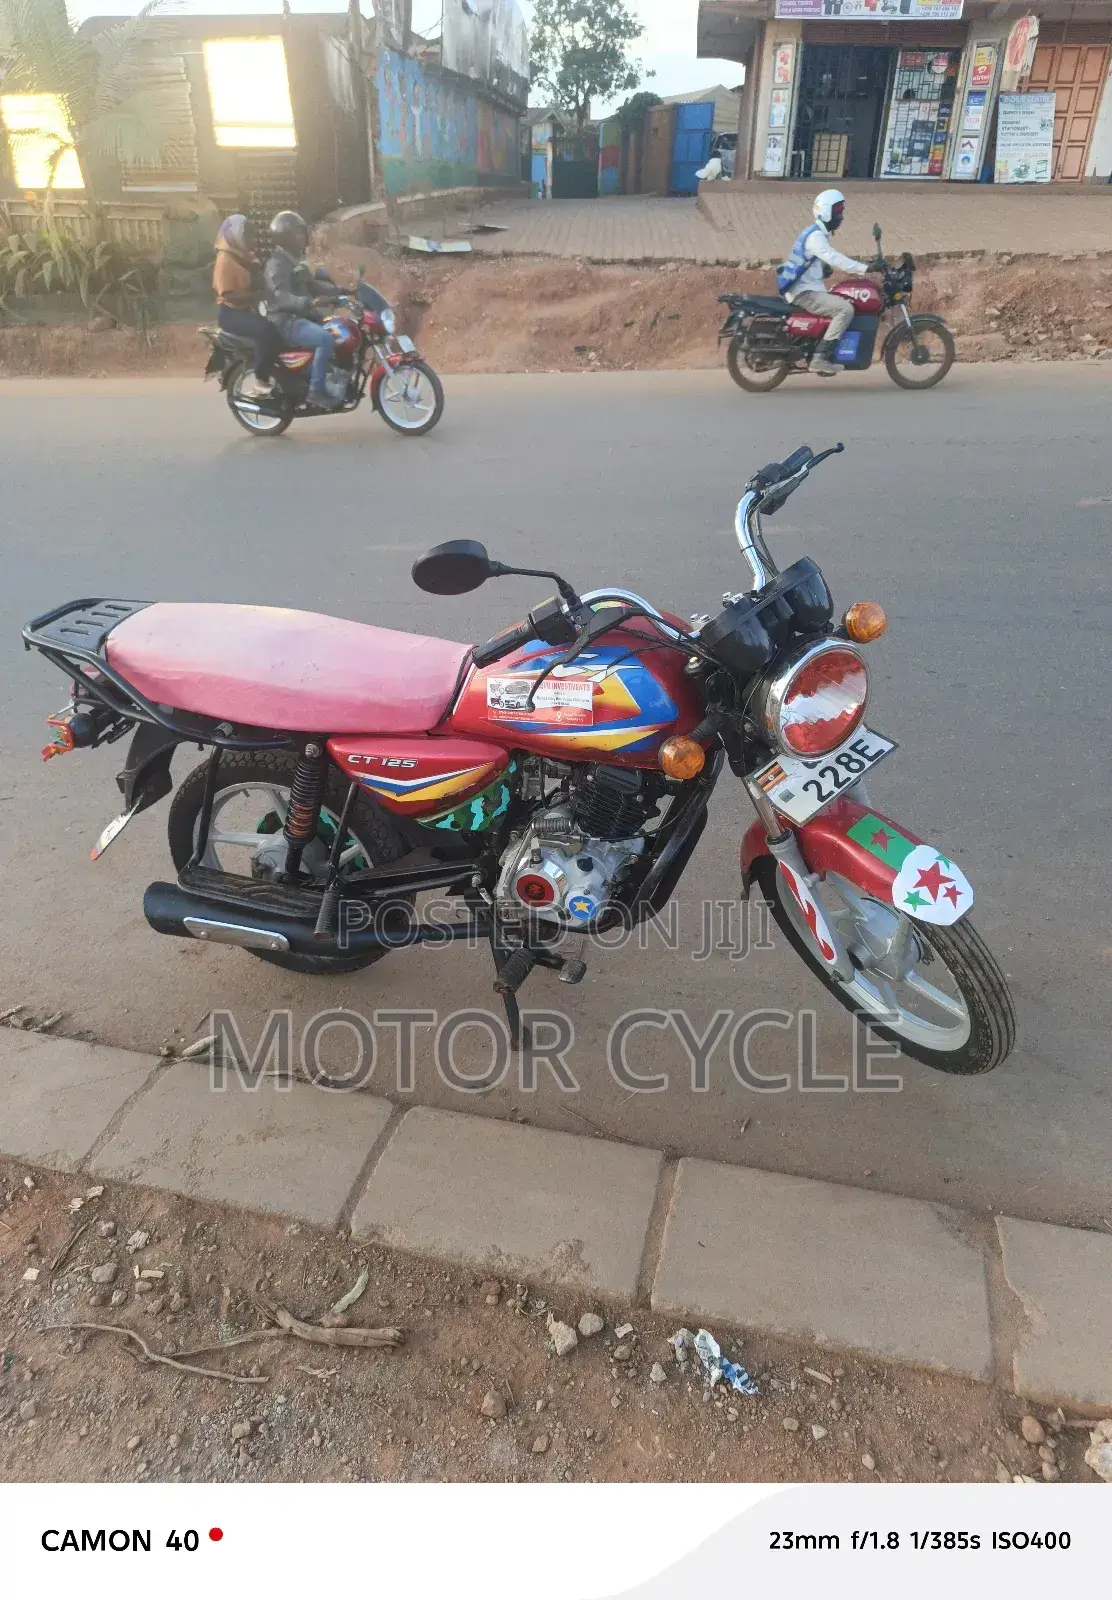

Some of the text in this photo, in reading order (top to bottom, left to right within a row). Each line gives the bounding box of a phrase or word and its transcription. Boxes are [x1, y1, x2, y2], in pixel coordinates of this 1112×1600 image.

[551, 682, 591, 692] INVESTMENTS
[347, 754, 418, 768] CT 125
[802, 738, 886, 804] 228E
